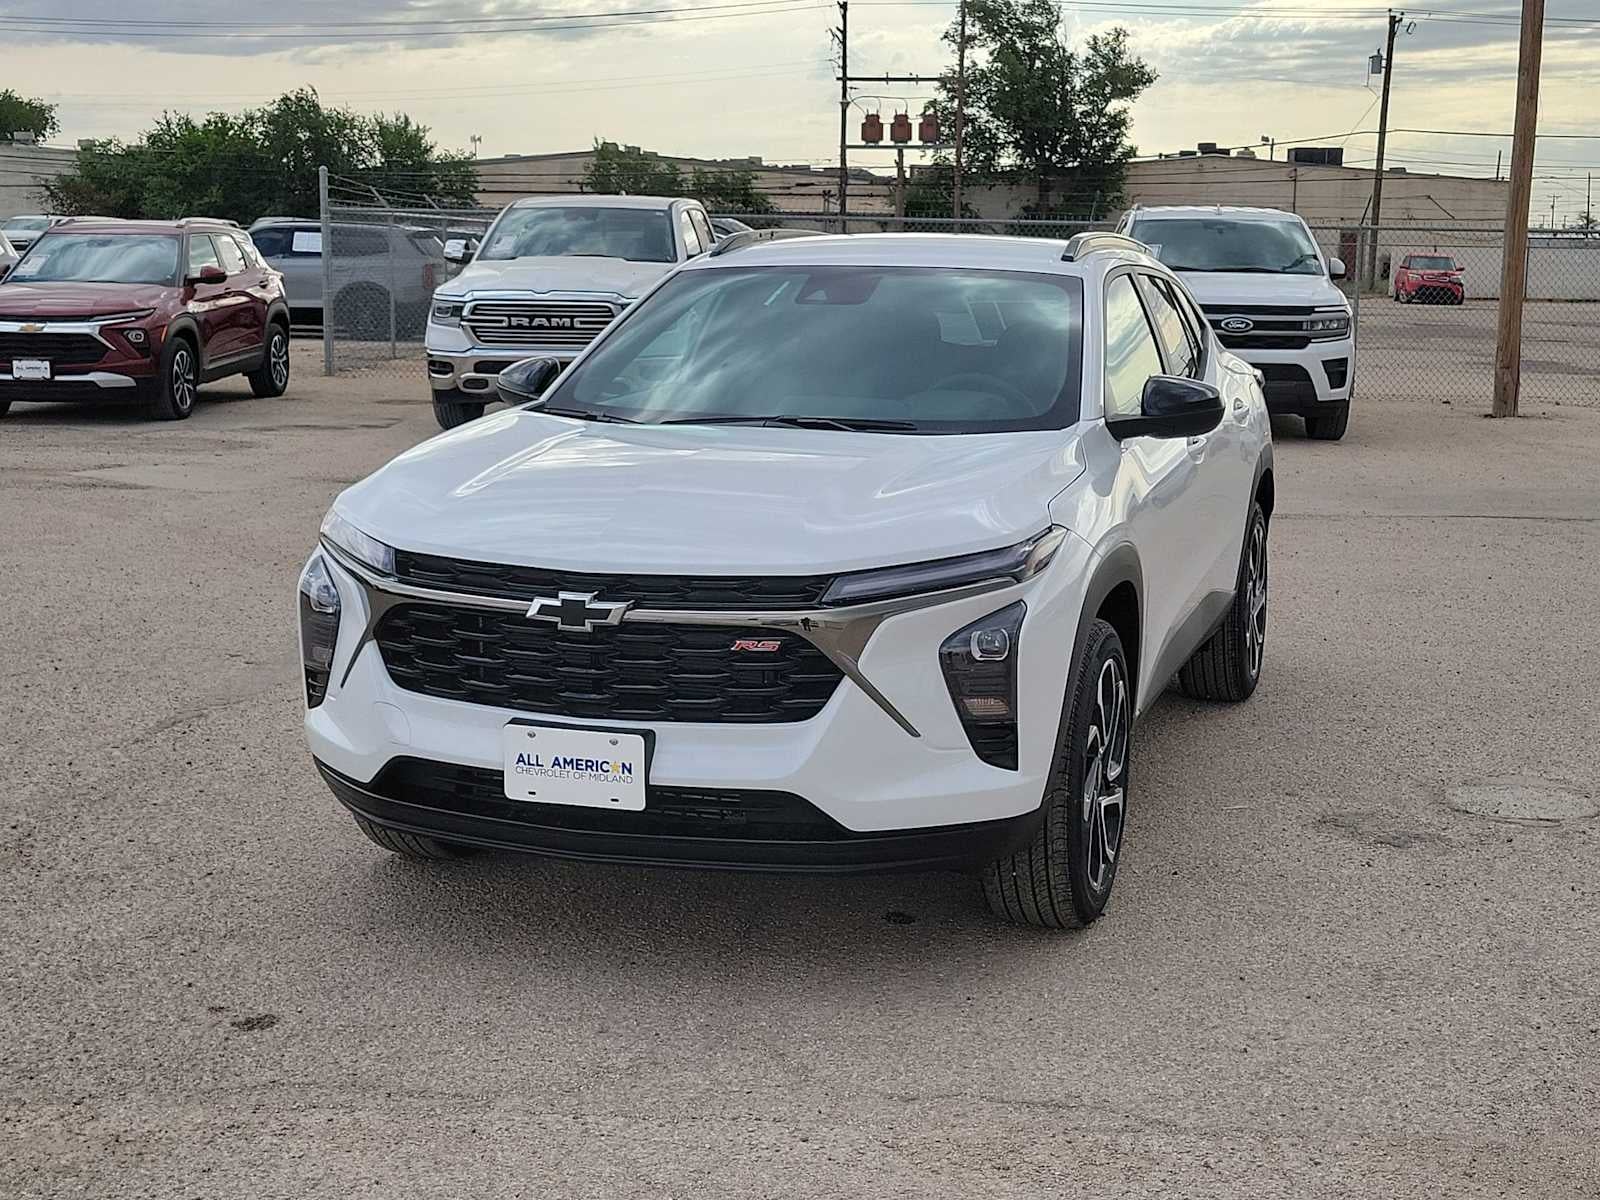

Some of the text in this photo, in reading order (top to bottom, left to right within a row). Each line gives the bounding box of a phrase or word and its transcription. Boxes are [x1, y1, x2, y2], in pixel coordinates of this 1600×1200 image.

[510, 317, 571, 327] RAM
[730, 640, 781, 652] RS
[515, 753, 633, 775] ALL AMERICN
[515, 765, 634, 785] CHEVROLET OF MIDLAND
